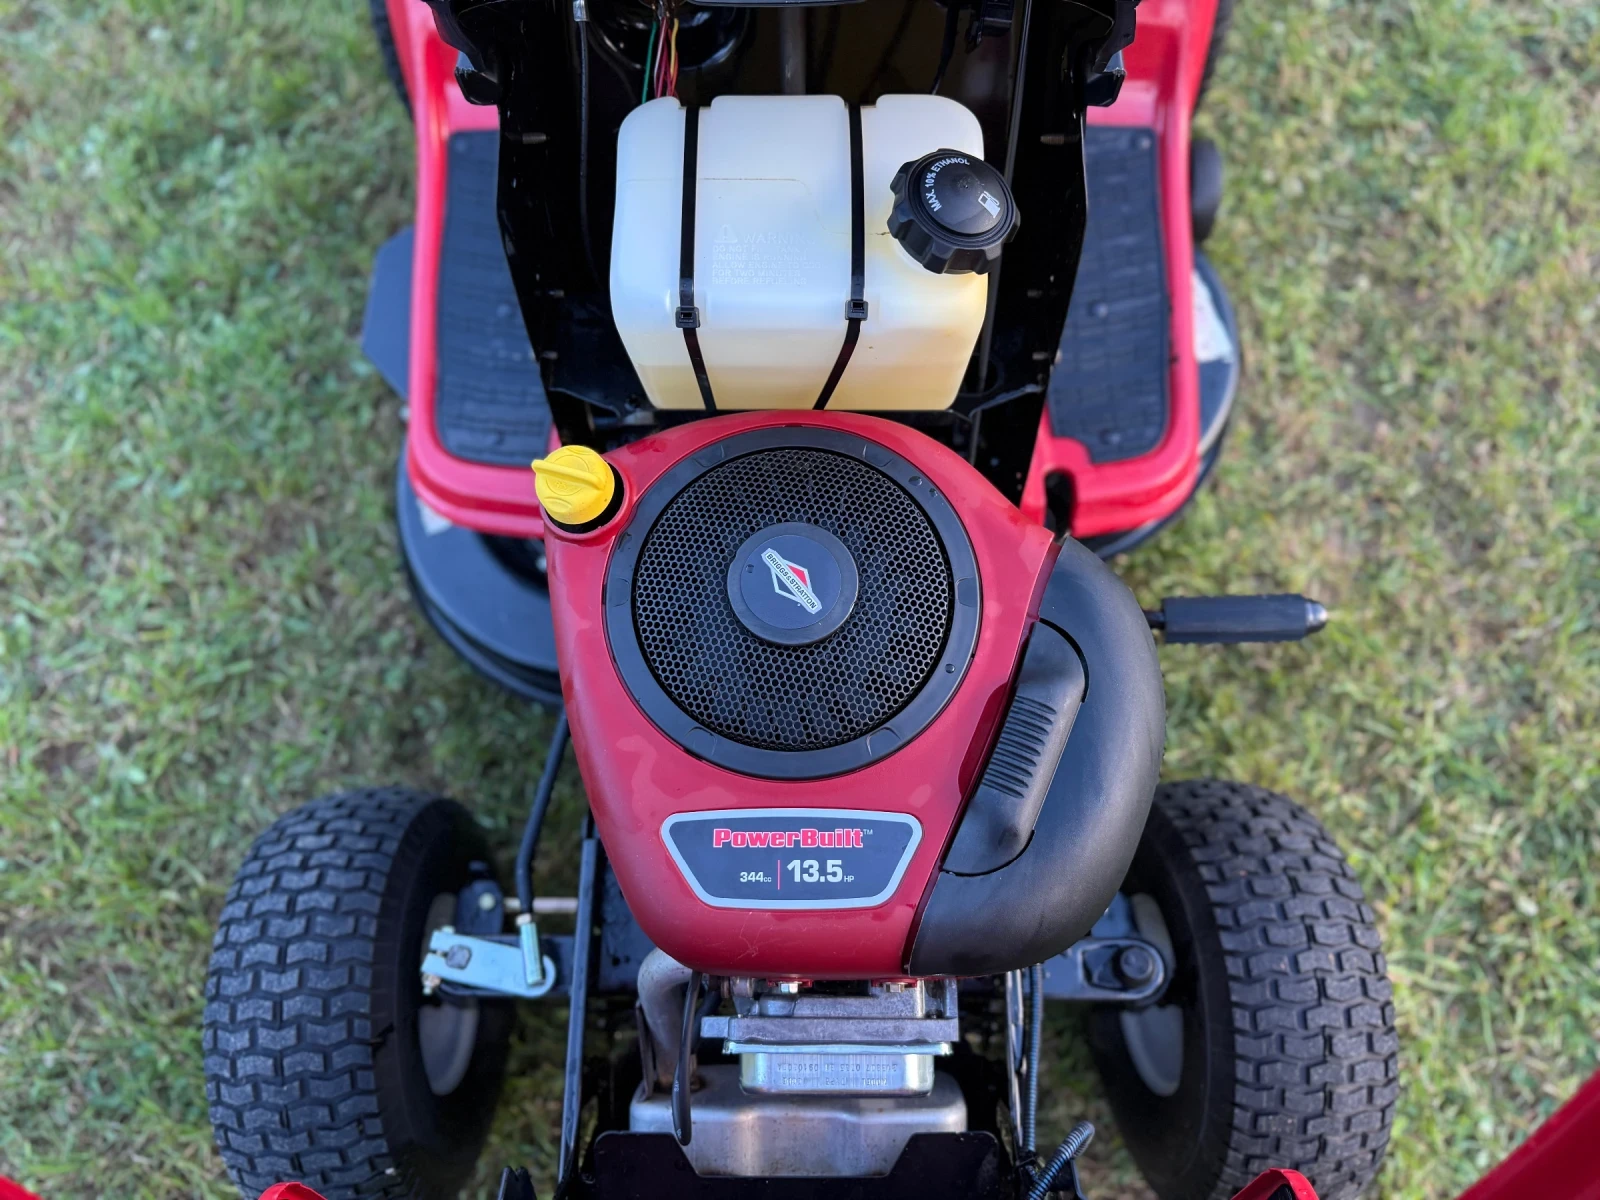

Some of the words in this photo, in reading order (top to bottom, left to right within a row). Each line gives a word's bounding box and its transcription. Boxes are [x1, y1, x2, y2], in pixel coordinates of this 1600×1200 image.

[931, 157, 970, 172] ETHANOL
[925, 172, 937, 188] 10%
[926, 188, 942, 212] MAX.
[712, 261, 747, 269] ALLOW
[712, 269, 732, 277] FOR
[734, 269, 755, 277] TWO
